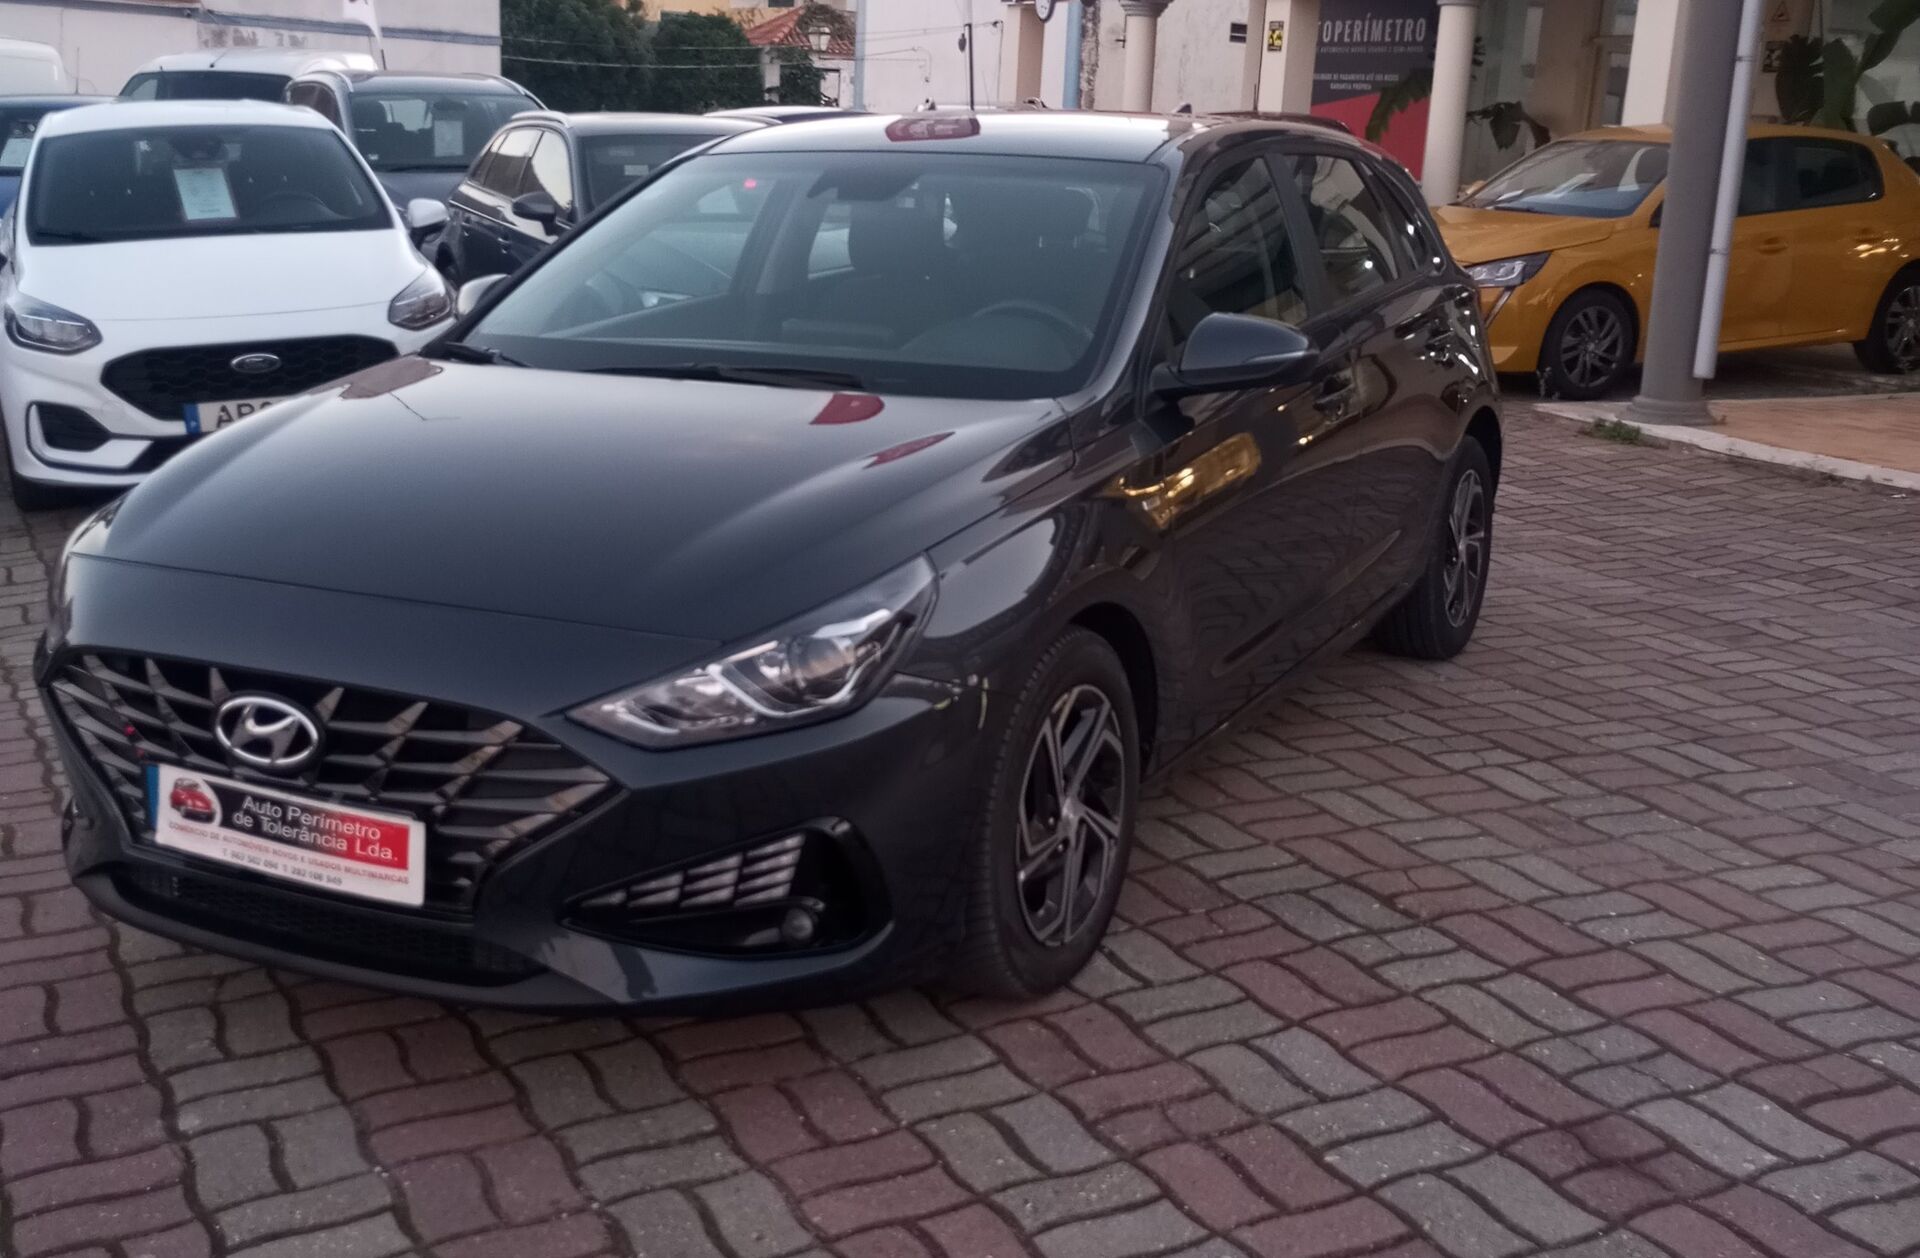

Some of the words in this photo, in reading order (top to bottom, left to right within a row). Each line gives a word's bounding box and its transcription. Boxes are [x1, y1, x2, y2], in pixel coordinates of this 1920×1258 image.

[1318, 12, 1426, 43] OPERÍMETRO
[243, 796, 282, 818] Auto
[233, 811, 254, 828] de
[260, 816, 347, 851] Tolerância
[355, 839, 398, 861] Lda.
